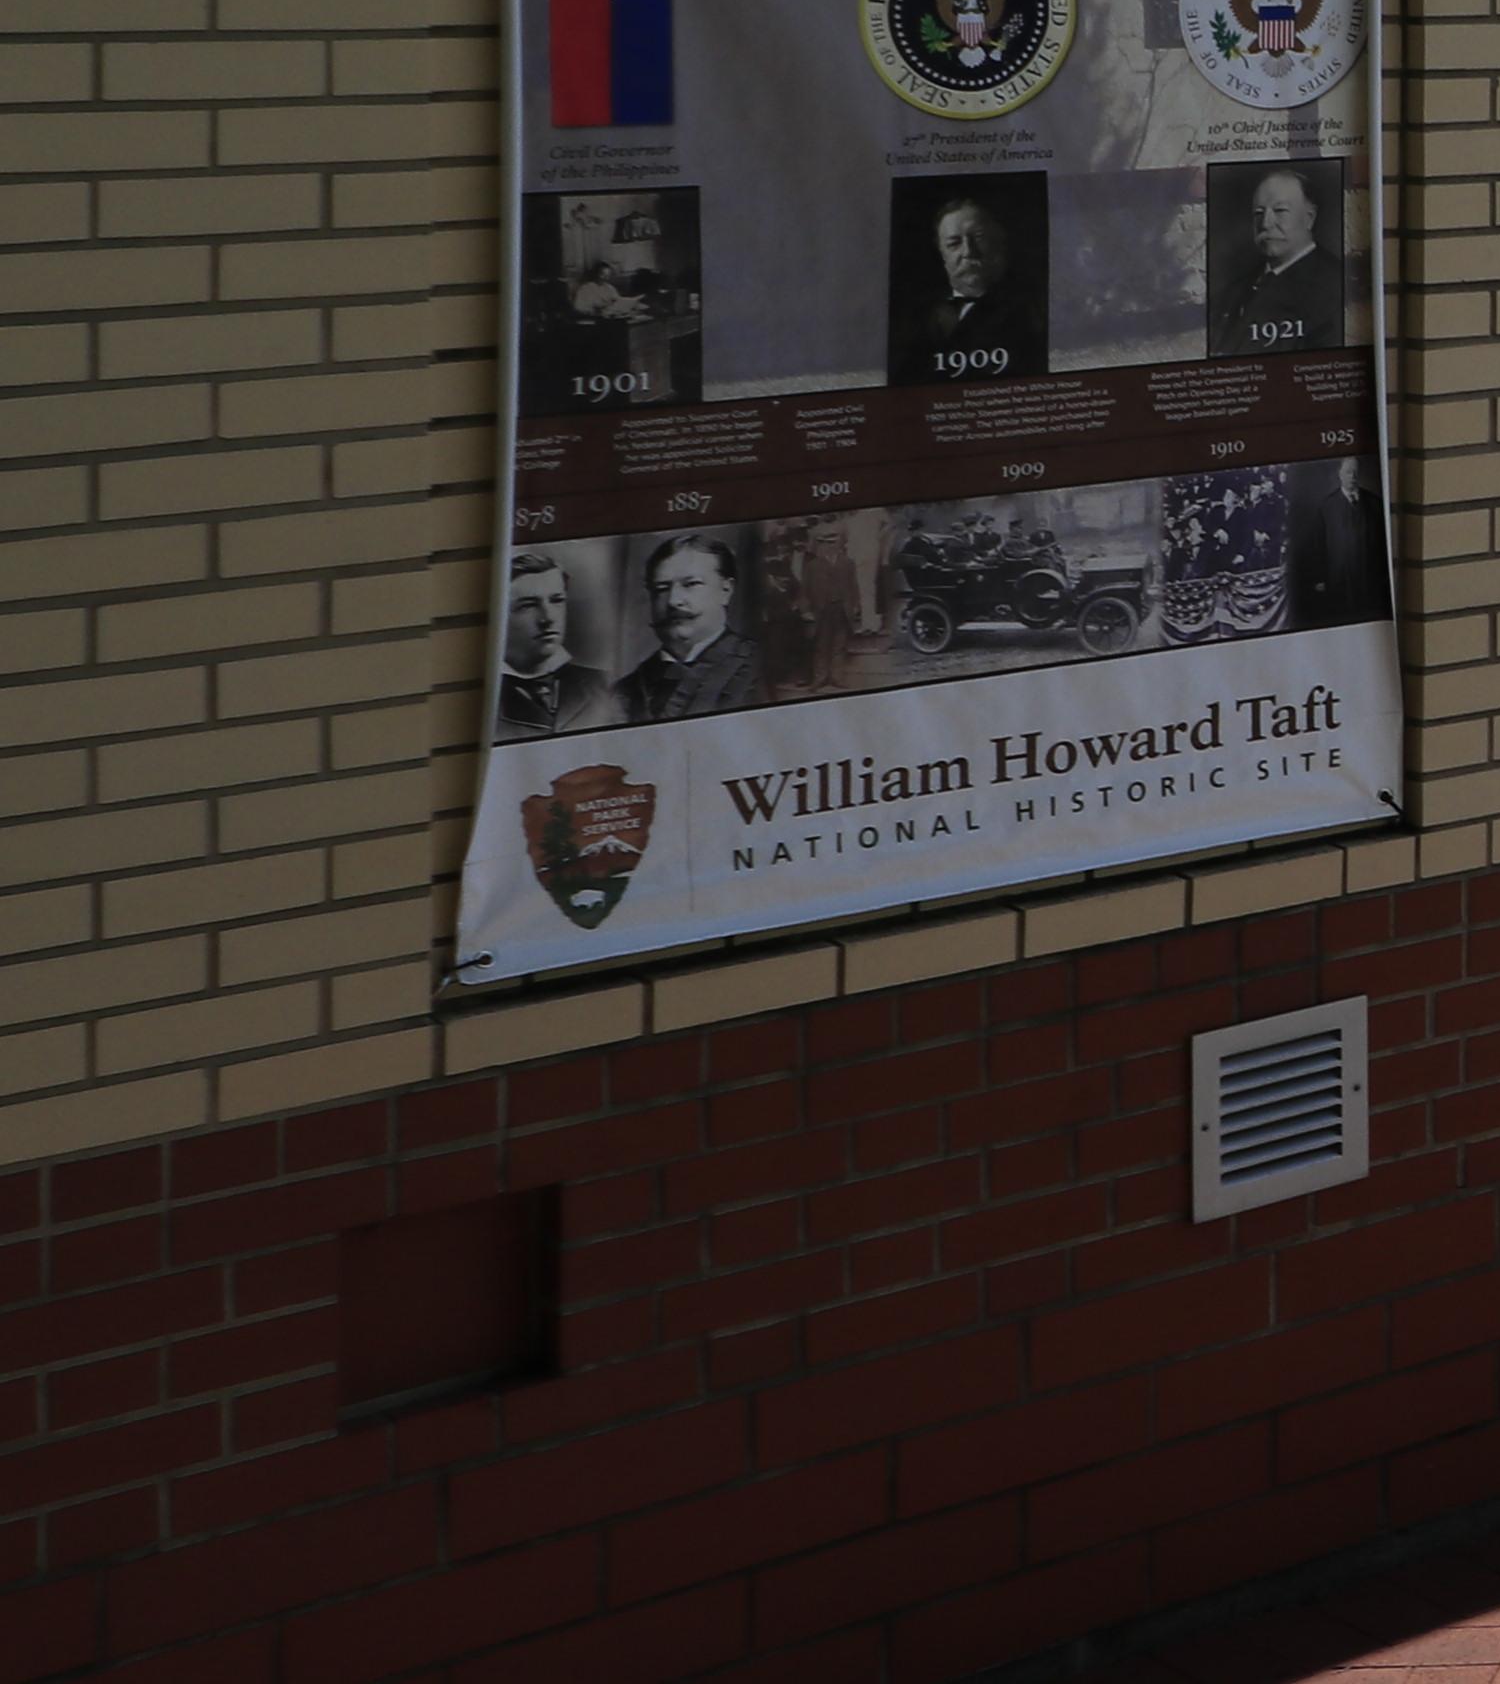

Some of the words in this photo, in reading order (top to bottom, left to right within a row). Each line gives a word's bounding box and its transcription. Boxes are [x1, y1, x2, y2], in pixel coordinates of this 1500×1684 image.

[870, 13, 886, 43] THE
[1186, 9, 1203, 44] THE
[879, 46, 896, 66] OF
[1199, 51, 1218, 71] OF
[993, 38, 1061, 106] STATES
[1298, 57, 1343, 97] STATES
[895, 65, 953, 108] SEAL
[1225, 73, 1262, 99] SEAL
[929, 130, 998, 146] President
[1016, 128, 1036, 143] the
[1232, 120, 1265, 135] Chief
[1265, 119, 1307, 136] Justice
[1324, 117, 1343, 131] the
[1186, 139, 1229, 154] United
[1231, 138, 1268, 152] States
[1269, 136, 1325, 152] Supreme
[1328, 134, 1365, 147] Court
[885, 150, 931, 166] United
[933, 149, 977, 164] States
[998, 146, 1054, 160] America
[1249, 320, 1305, 347] 1921
[933, 347, 1009, 378] 1909
[570, 372, 652, 403] 1901
[1320, 428, 1355, 446] 1925
[1210, 440, 1246, 459] 1910
[1001, 461, 1045, 482] 1909
[811, 481, 850, 501] 1901
[666, 491, 712, 515] 1887
[516, 504, 556, 531] 878
[721, 756, 972, 826] William
[990, 702, 1224, 785] Howard
[1234, 685, 1341, 746] Taft
[575, 793, 649, 813] NATIONAL
[732, 810, 980, 872] NATIONAL
[1016, 767, 1226, 822] HISTORIC
[1256, 747, 1343, 780] SITE
[592, 807, 631, 822] PARK
[581, 817, 641, 836] SERVICE
